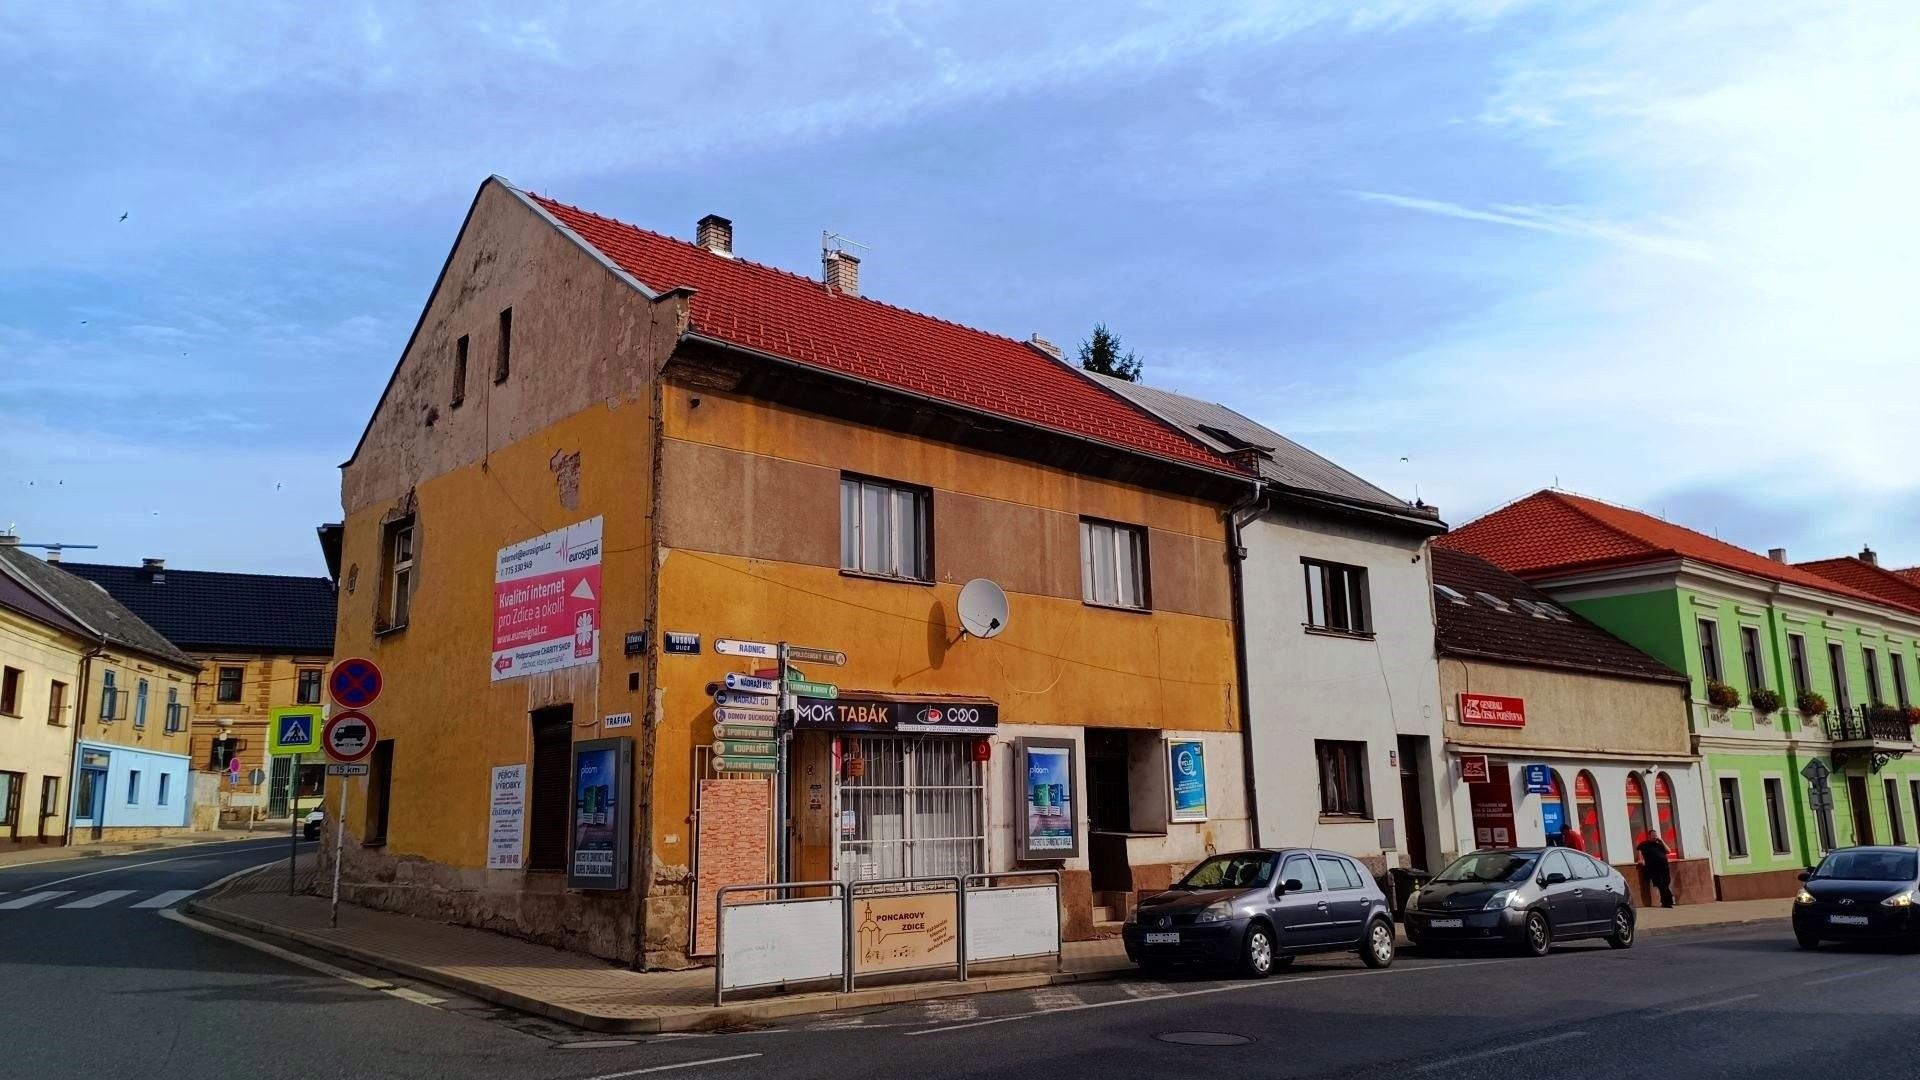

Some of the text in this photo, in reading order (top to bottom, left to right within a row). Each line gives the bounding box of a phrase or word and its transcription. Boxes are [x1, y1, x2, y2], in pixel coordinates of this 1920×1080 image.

[568, 544, 599, 562] eurosignal
[499, 577, 565, 608] Kvalitní internet
[498, 614, 511, 632] pro
[512, 606, 534, 625] Zdice
[535, 608, 541, 619] a
[496, 625, 547, 645] www.eurosignal.cz
[671, 635, 696, 645] HUSOVA
[739, 644, 766, 655] RADNICE
[740, 677, 773, 690] NÁDRAŽÍ BUS
[1479, 700, 1503, 711] GENERALI
[727, 712, 747, 720] DOMOV
[837, 703, 889, 723] TABÁK
[1480, 709, 1497, 720] ČESKÁ
[606, 715, 631, 726] TRAFIKA
[347, 765, 360, 773] km
[1029, 762, 1049, 774] ploom
[495, 780, 522, 790] VÝROBKY
[876, 911, 925, 922] PONCAROVY
[901, 922, 926, 931] ZDICE
